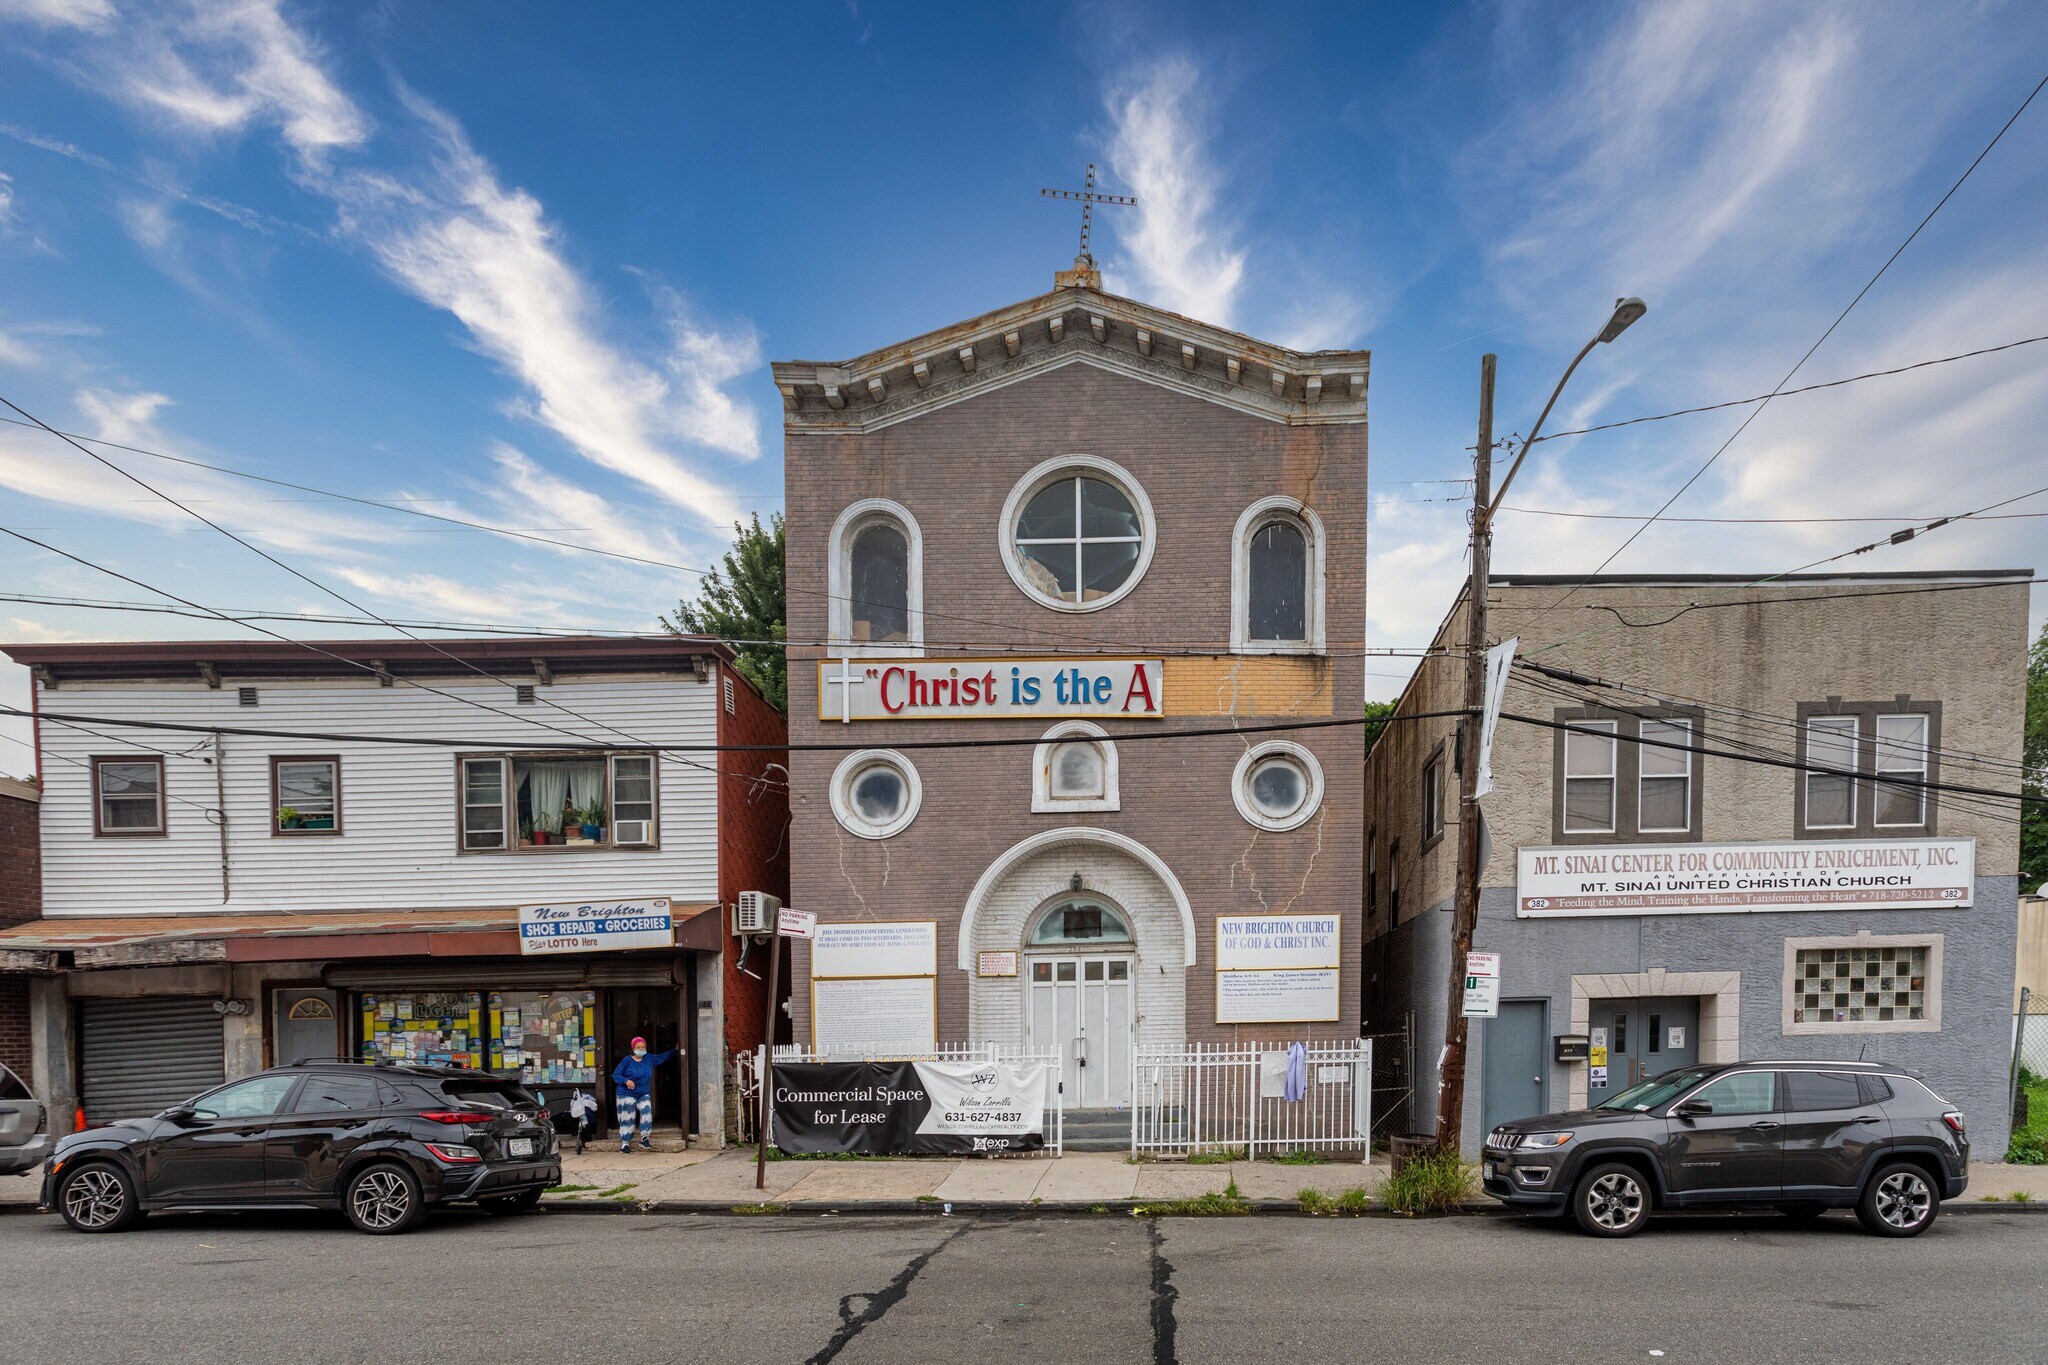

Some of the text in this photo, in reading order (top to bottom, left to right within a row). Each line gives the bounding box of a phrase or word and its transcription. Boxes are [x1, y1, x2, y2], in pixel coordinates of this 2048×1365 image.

[1010, 666, 1041, 705] is
[1052, 668, 1112, 705] the
[1121, 663, 1157, 712] A
[1533, 847, 1959, 875] MT. SINAI CENTER FOR COMMUNITY ENRICHMENT, INC.
[1581, 876, 1911, 892] MT. SINAI UNITED CHRISTIAN CHURCH
[1599, 897, 1614, 906] the
[1617, 896, 1645, 907] Mind,
[1648, 895, 1688, 908] Training
[1691, 895, 1707, 904] the
[1710, 894, 1743, 905] Hands,
[1745, 892, 1809, 904] Transforming
[1812, 892, 1828, 901] the
[1869, 889, 1935, 899] 718-720-5212
[1944, 890, 1958, 898] 382
[1531, 899, 1545, 908] 382
[534, 904, 645, 919] New Brighton
[526, 917, 666, 937] SHOE REPAIR GROCERIES
[1222, 920, 1334, 934] NEW BRIGHTON CHURCH
[528, 937, 598, 950] Play LOTTO Here
[1225, 935, 1331, 949] OF GOD & CHRIST INC.
[776, 1086, 924, 1106] Commercial Space
[959, 1096, 981, 1107] Wilson
[814, 1110, 886, 1125] for Lease
[945, 1112, 1021, 1122] 631-627-4837
